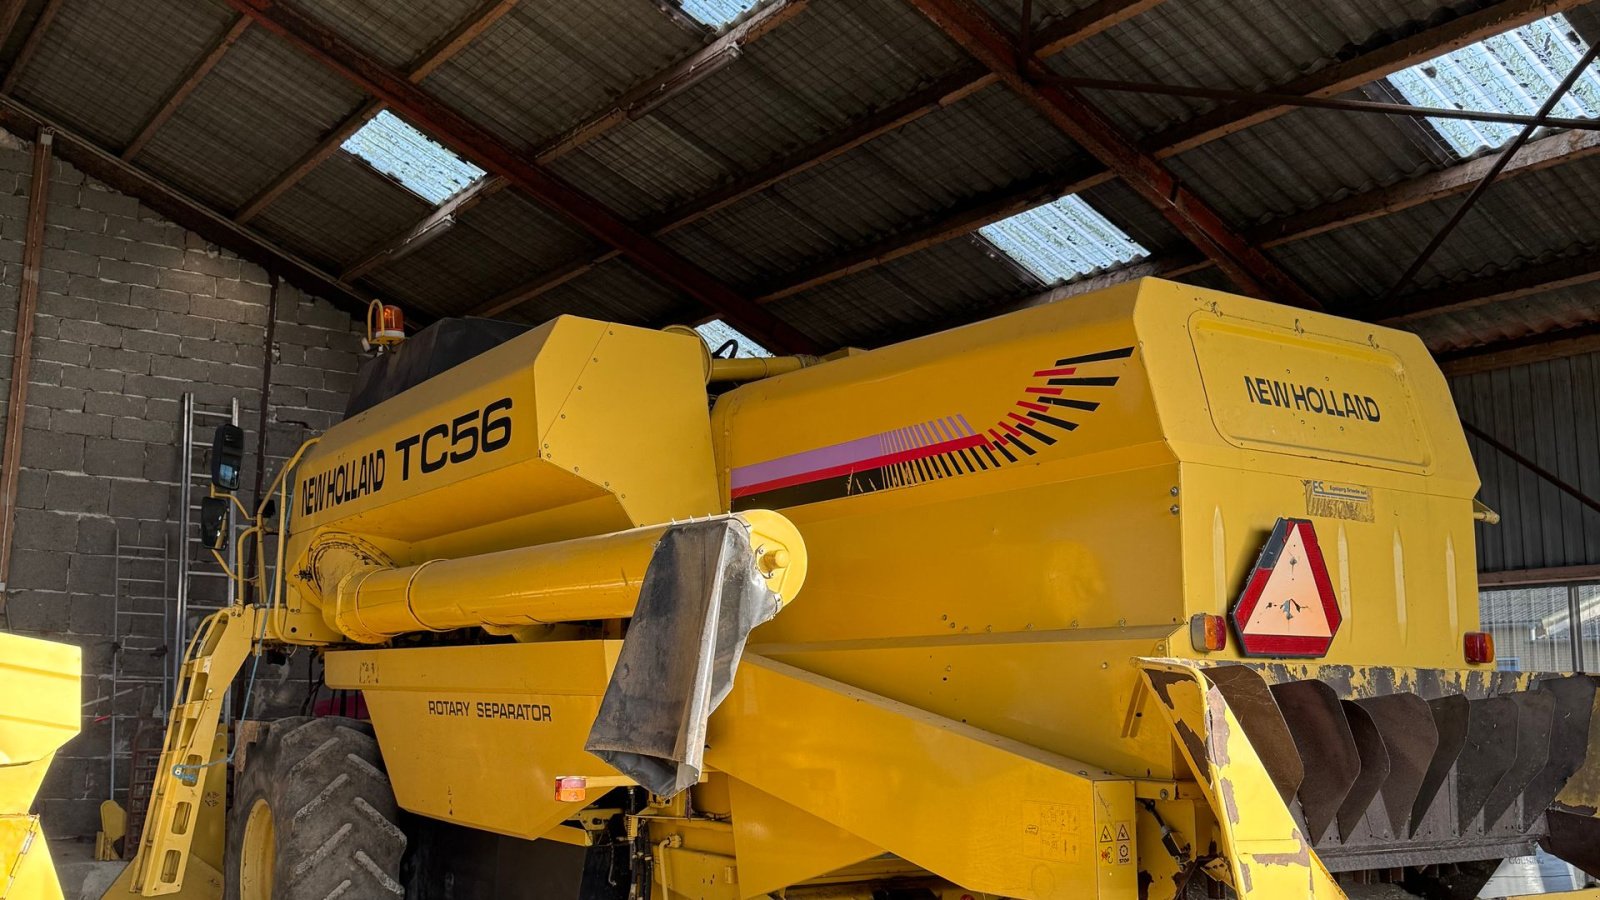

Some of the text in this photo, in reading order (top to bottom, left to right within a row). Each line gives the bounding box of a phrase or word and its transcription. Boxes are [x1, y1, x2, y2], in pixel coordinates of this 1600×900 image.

[1244, 375, 1381, 422] NEW HOLLAND
[301, 397, 513, 517] NEW HOLLAND TC56
[428, 700, 552, 722] ROTARY SEPARATOR
